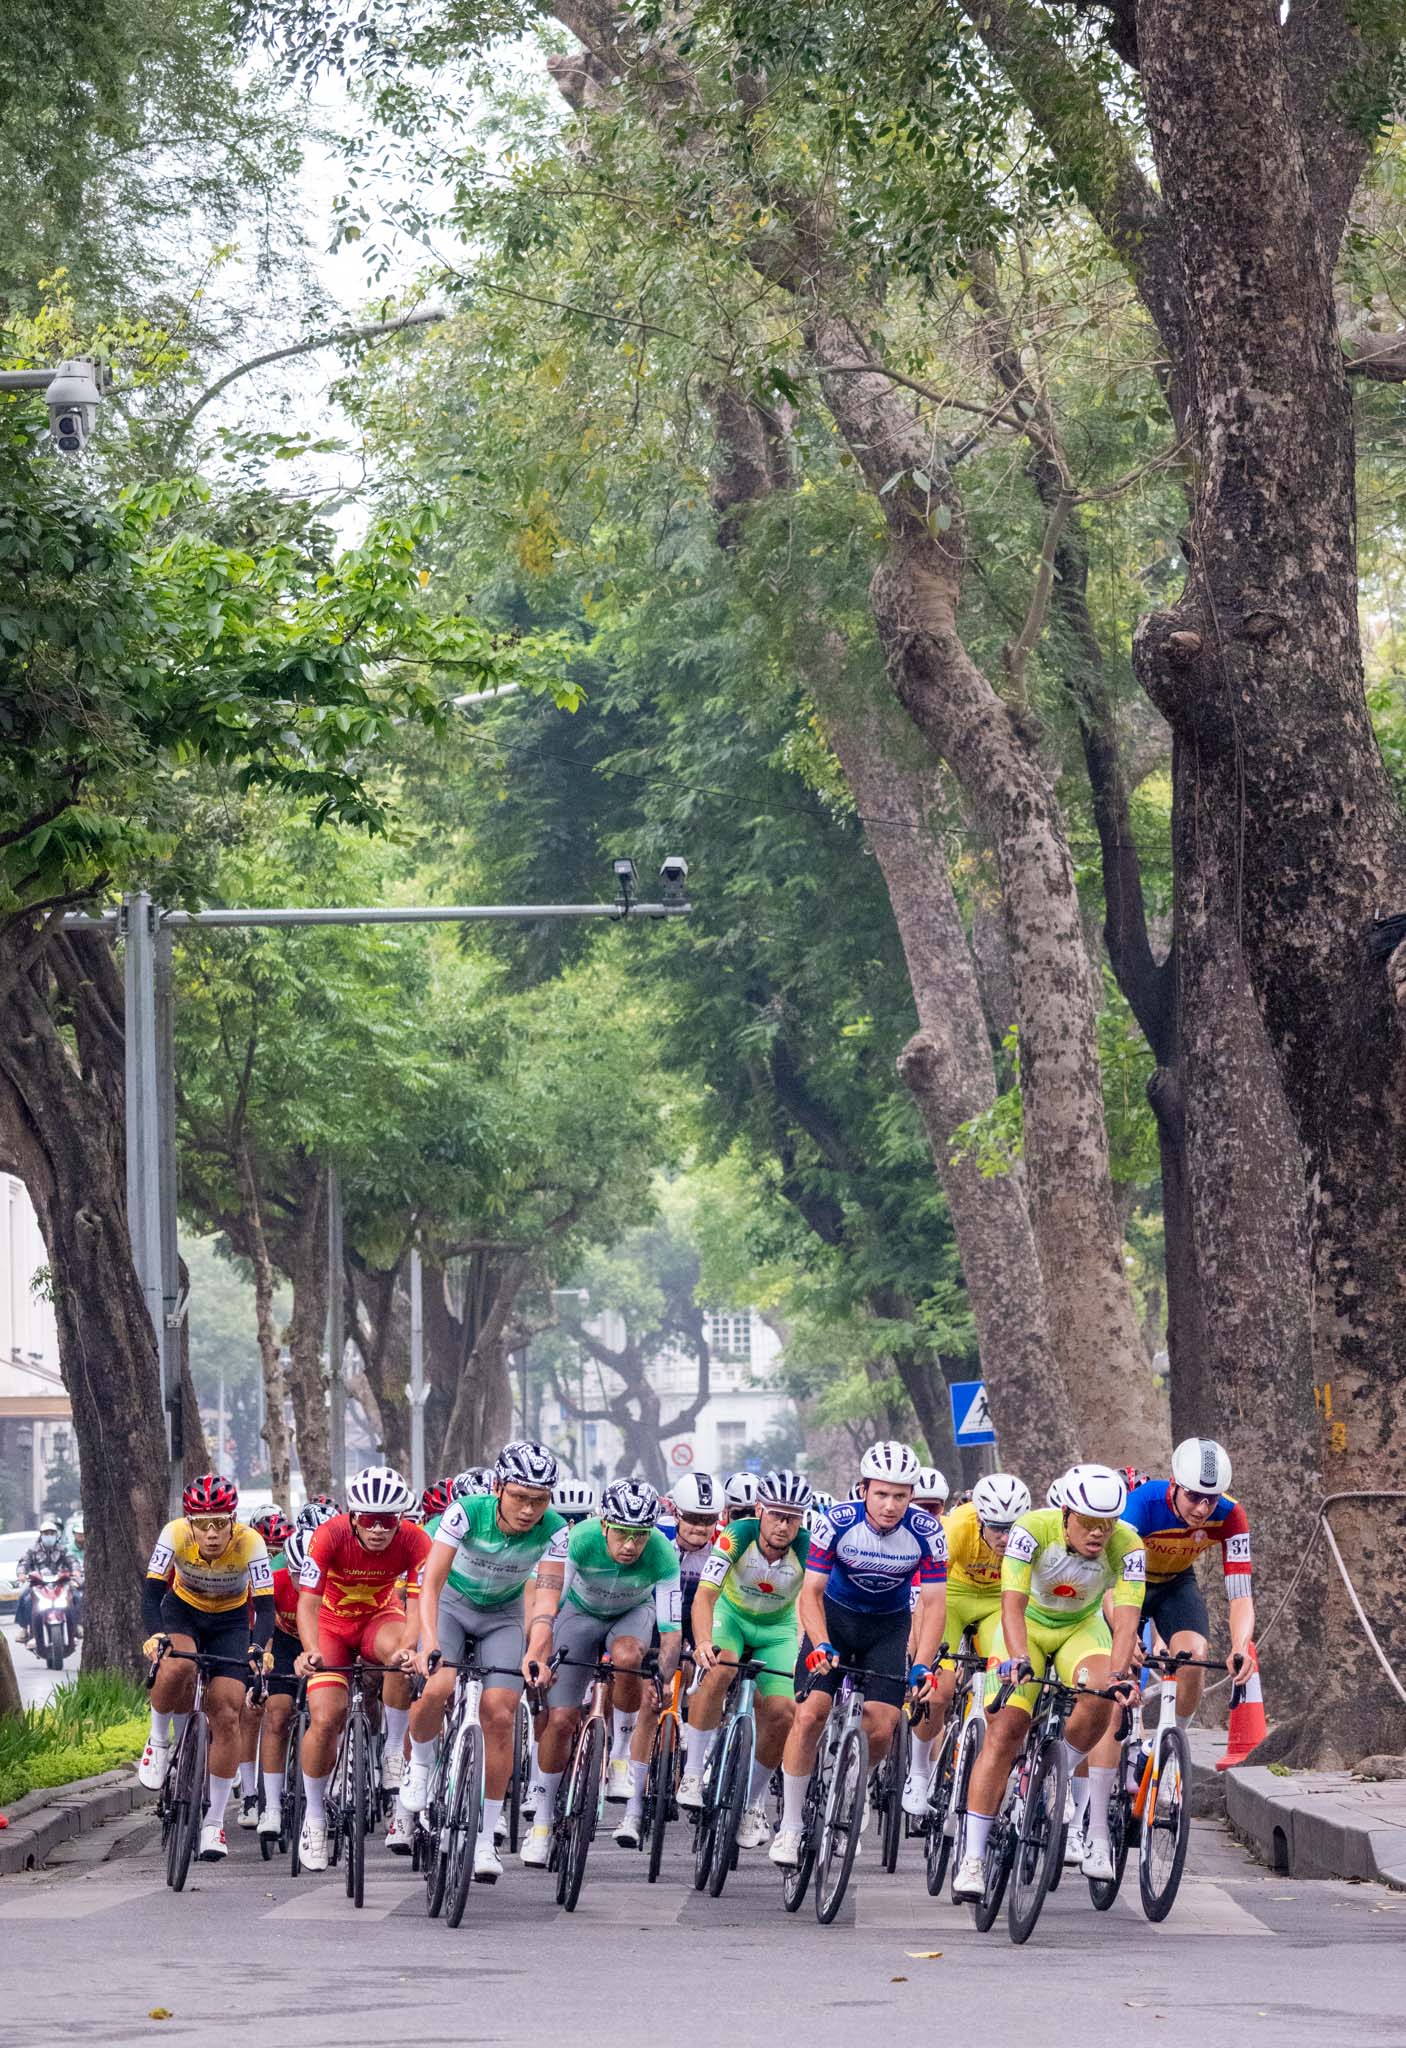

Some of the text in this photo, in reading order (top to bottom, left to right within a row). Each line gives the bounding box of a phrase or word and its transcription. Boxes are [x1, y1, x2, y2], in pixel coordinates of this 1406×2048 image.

[833, 1509, 851, 1519] BM
[915, 1516, 935, 1530] BM
[812, 1519, 829, 1540] 97
[1232, 1538, 1248, 1556] 37
[253, 1563, 270, 1581] 15
